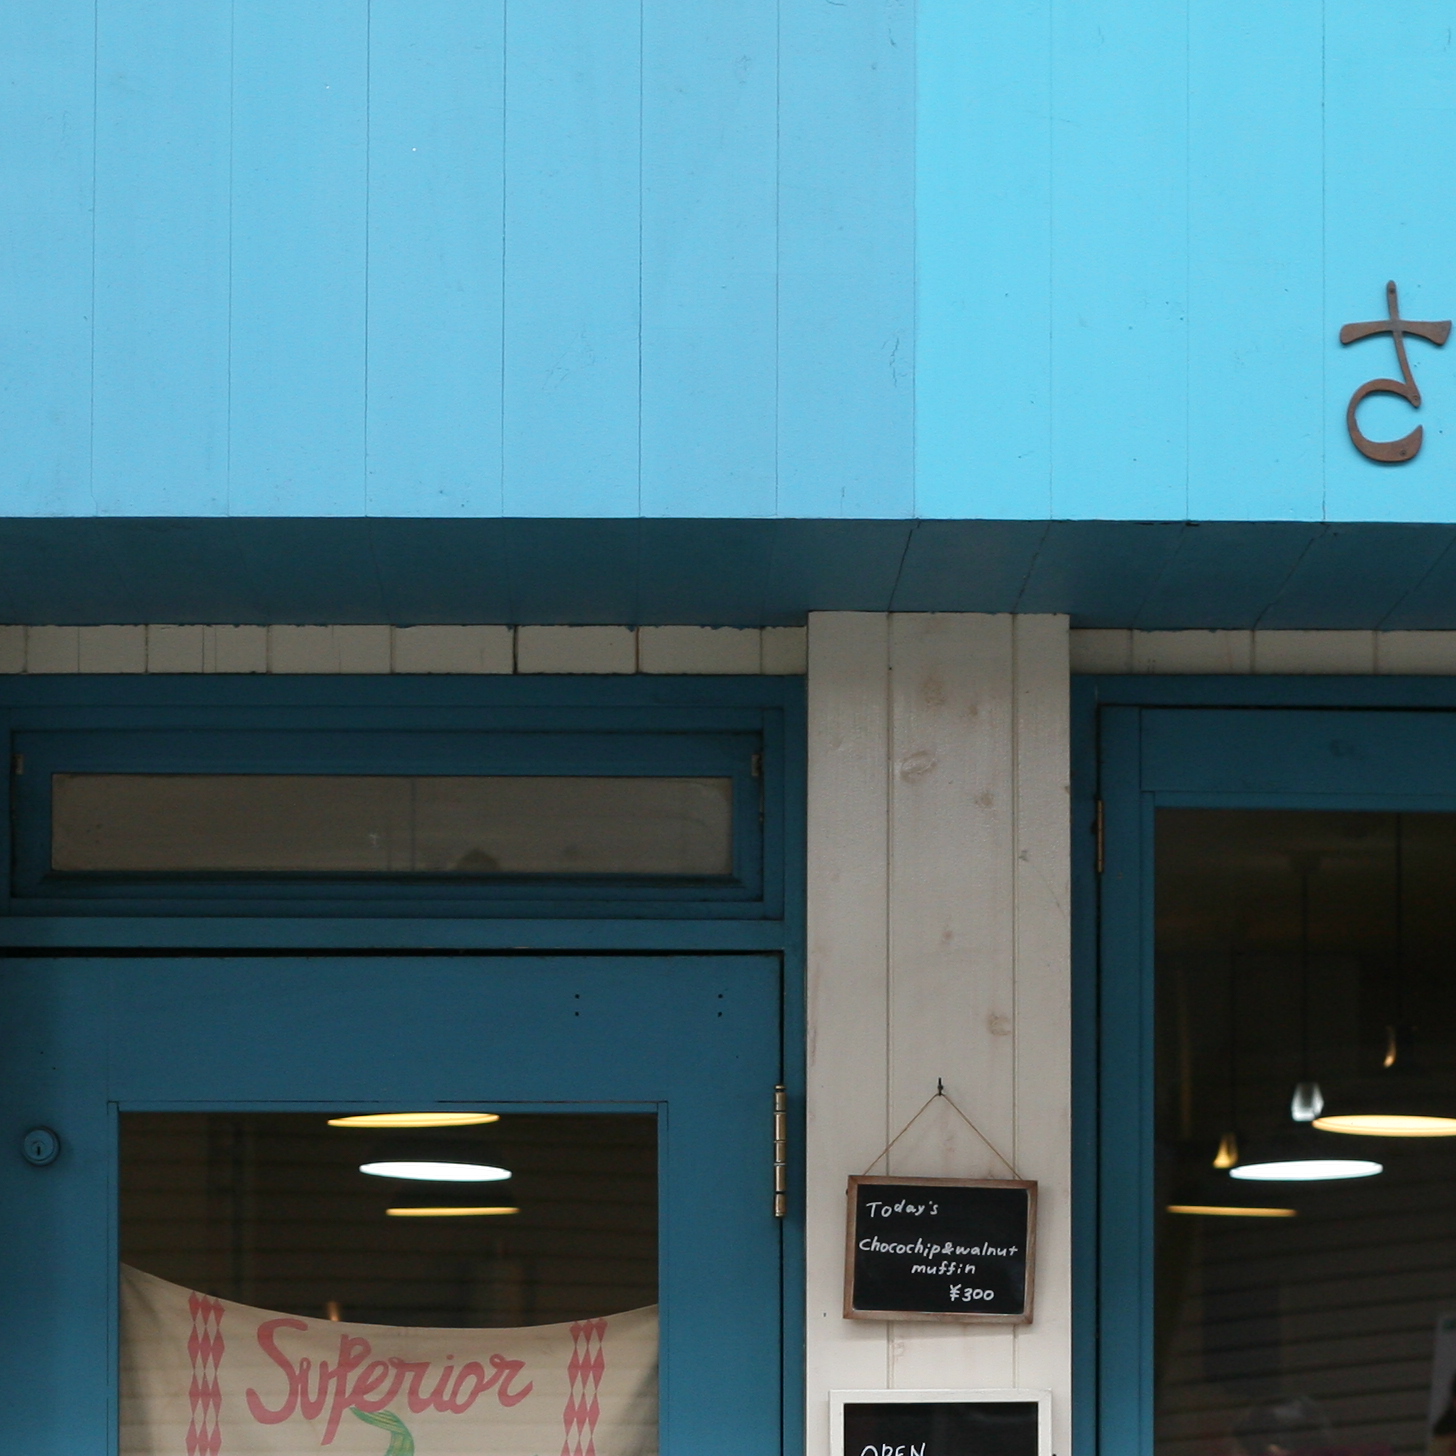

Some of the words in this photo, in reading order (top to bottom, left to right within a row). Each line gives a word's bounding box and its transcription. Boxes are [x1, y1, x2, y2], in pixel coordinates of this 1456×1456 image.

[866, 1199, 939, 1218] Today's
[911, 1260, 976, 1276] muffin
[949, 1283, 995, 1301] ¥300
[246, 1318, 534, 1446] Superior
